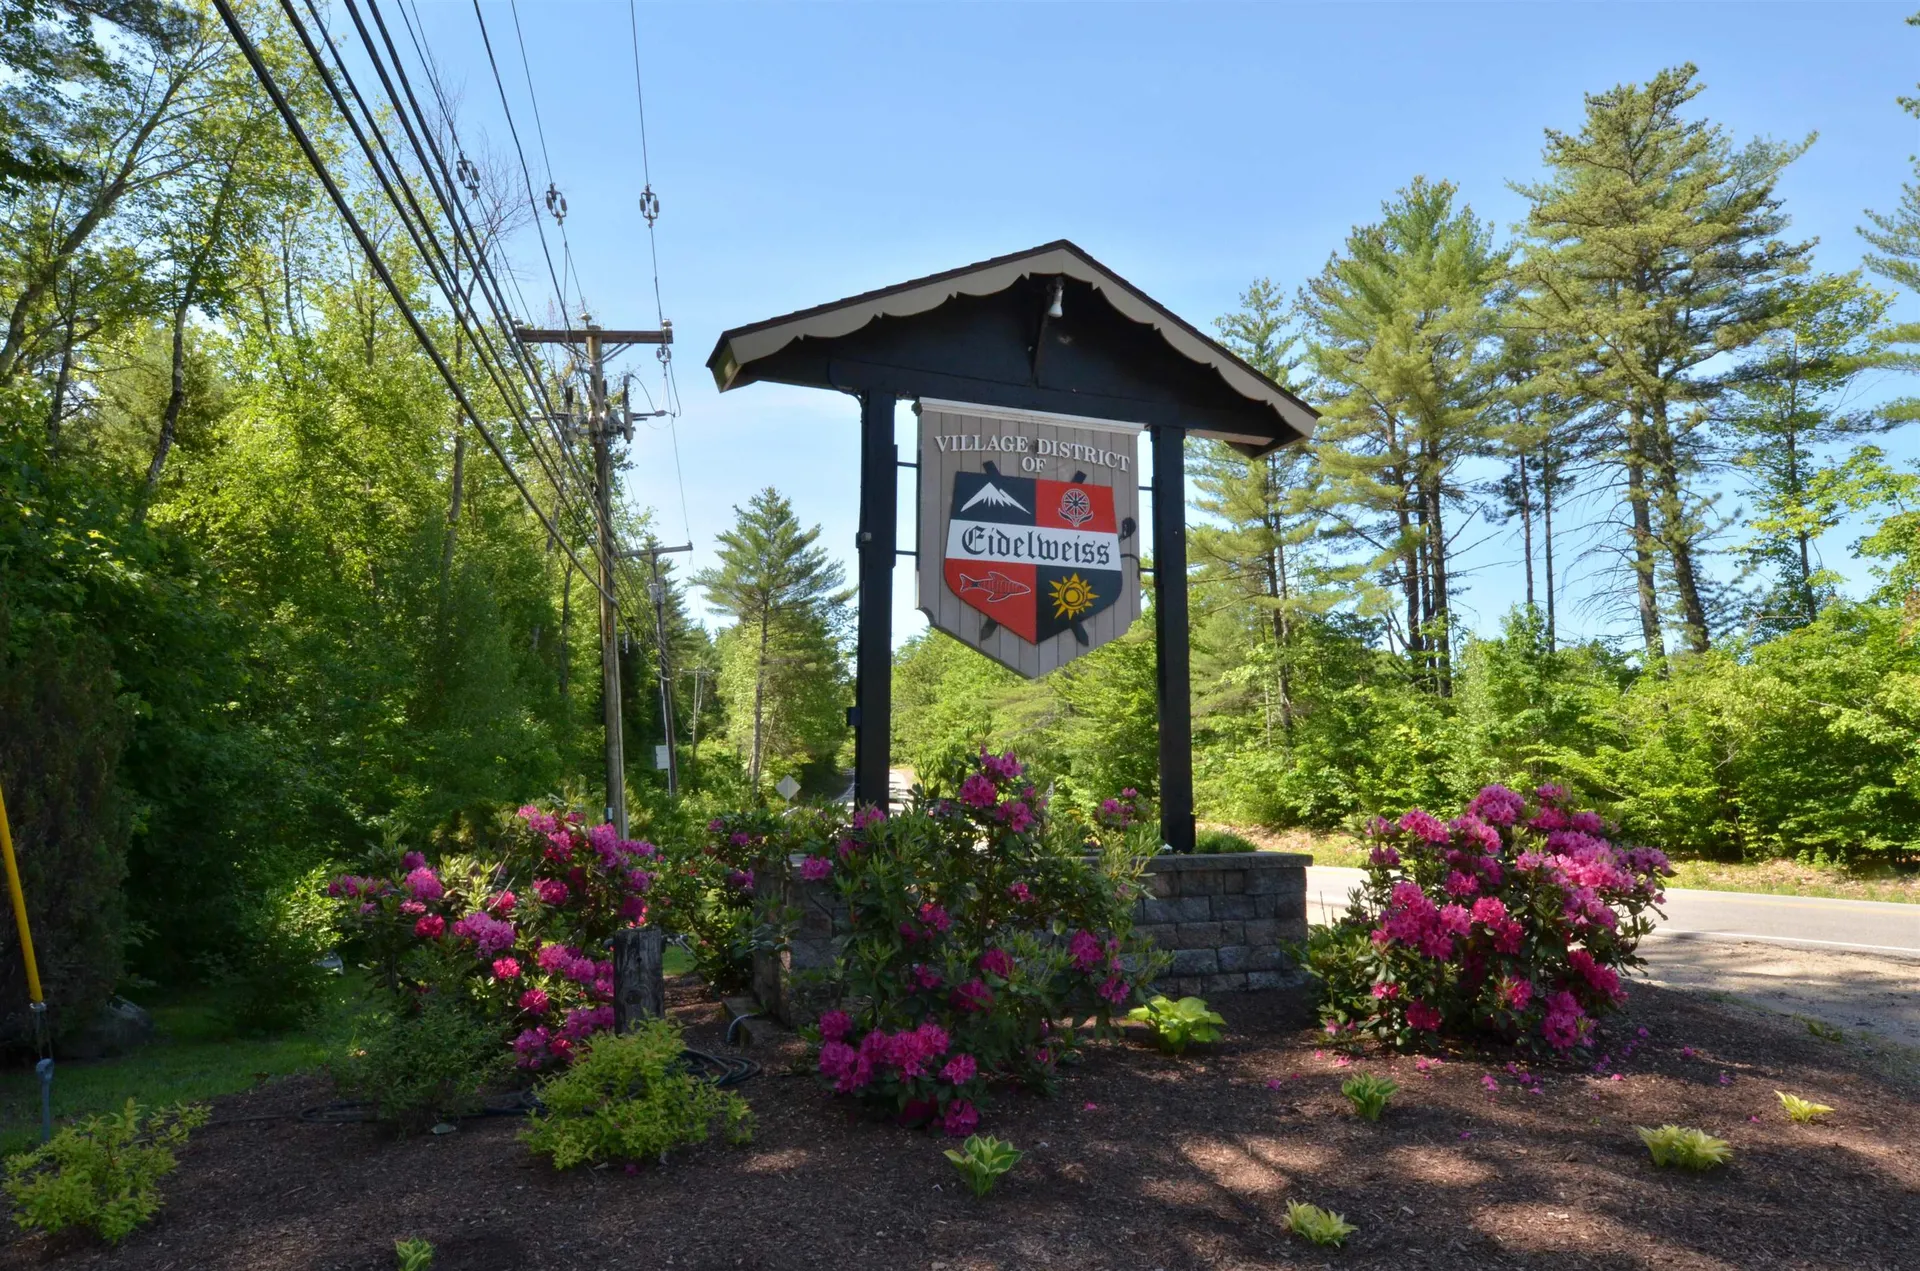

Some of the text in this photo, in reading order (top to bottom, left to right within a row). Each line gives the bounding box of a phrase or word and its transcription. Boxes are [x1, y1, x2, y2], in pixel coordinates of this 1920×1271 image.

[935, 434, 1130, 473] VILLAGE DISTRICT
[1021, 456, 1047, 473] OF
